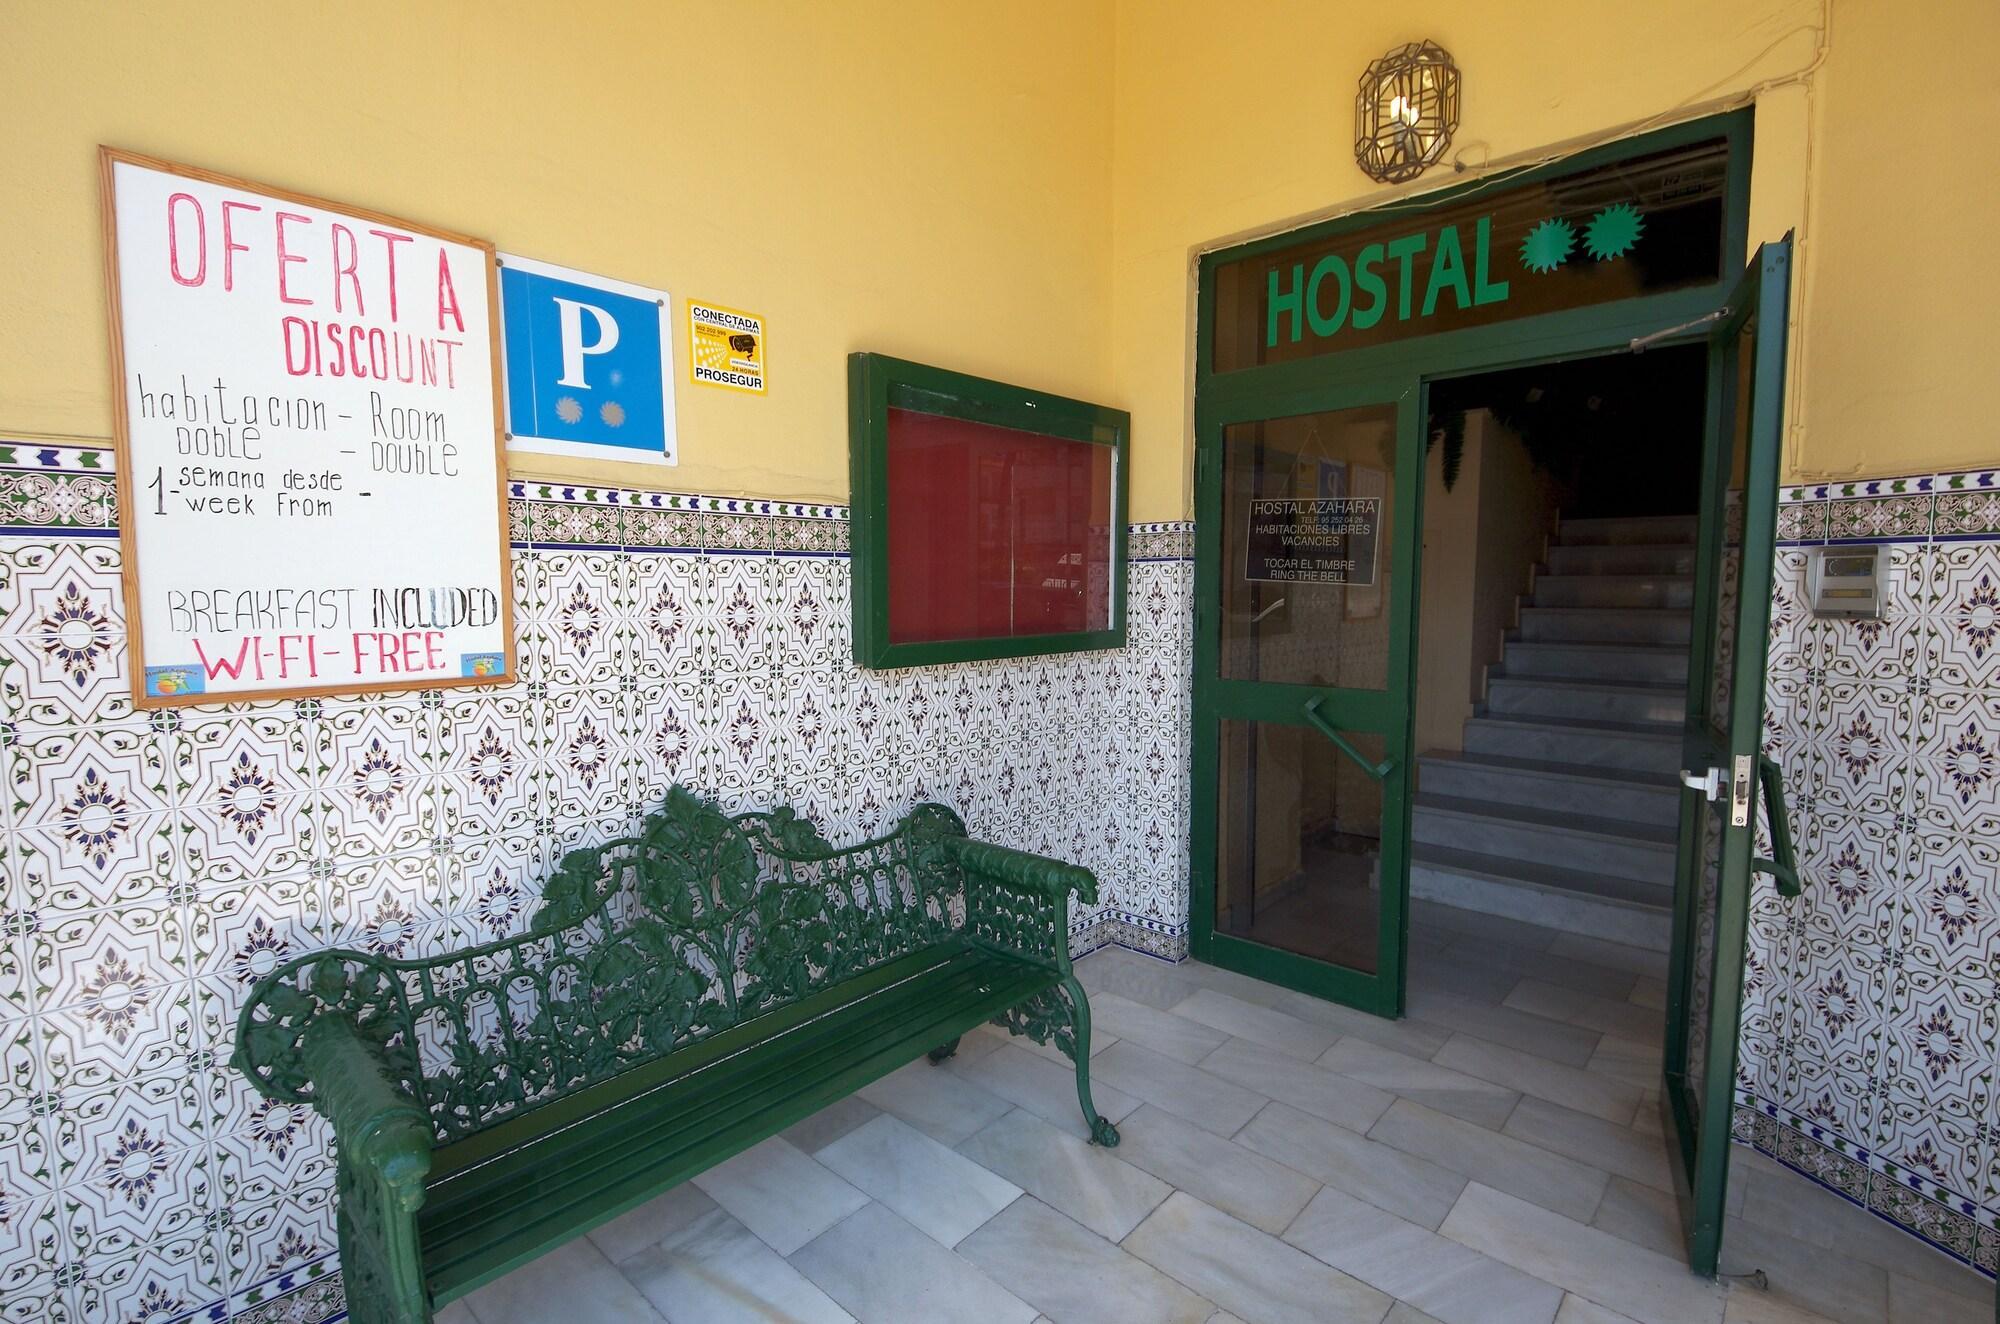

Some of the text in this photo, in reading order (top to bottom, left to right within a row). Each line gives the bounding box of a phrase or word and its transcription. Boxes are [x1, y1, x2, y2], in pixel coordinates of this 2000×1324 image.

[168, 193, 465, 333] OFERTA
[1266, 215, 1510, 348] HOSTAL
[693, 307, 760, 330] CONECTADA
[281, 315, 464, 389] DISCOUNT
[552, 296, 620, 390] P
[695, 367, 762, 389] PROSEGUR
[739, 367, 759, 376] HORAS
[179, 466, 265, 489] semana
[282, 468, 343, 491] desde
[185, 494, 255, 516] week
[1254, 500, 1376, 515] HOSTAL AZAHARA
[1255, 524, 1371, 535] HABITACIONES LIBRES
[1281, 536, 1340, 547] VACANCIES
[1264, 558, 1356, 571] TOCAR EL TIMBRE
[1270, 570, 1347, 583] RING THE BELL
[167, 587, 498, 633] BREAKFAST INCLUDED
[352, 630, 446, 674] FREE
